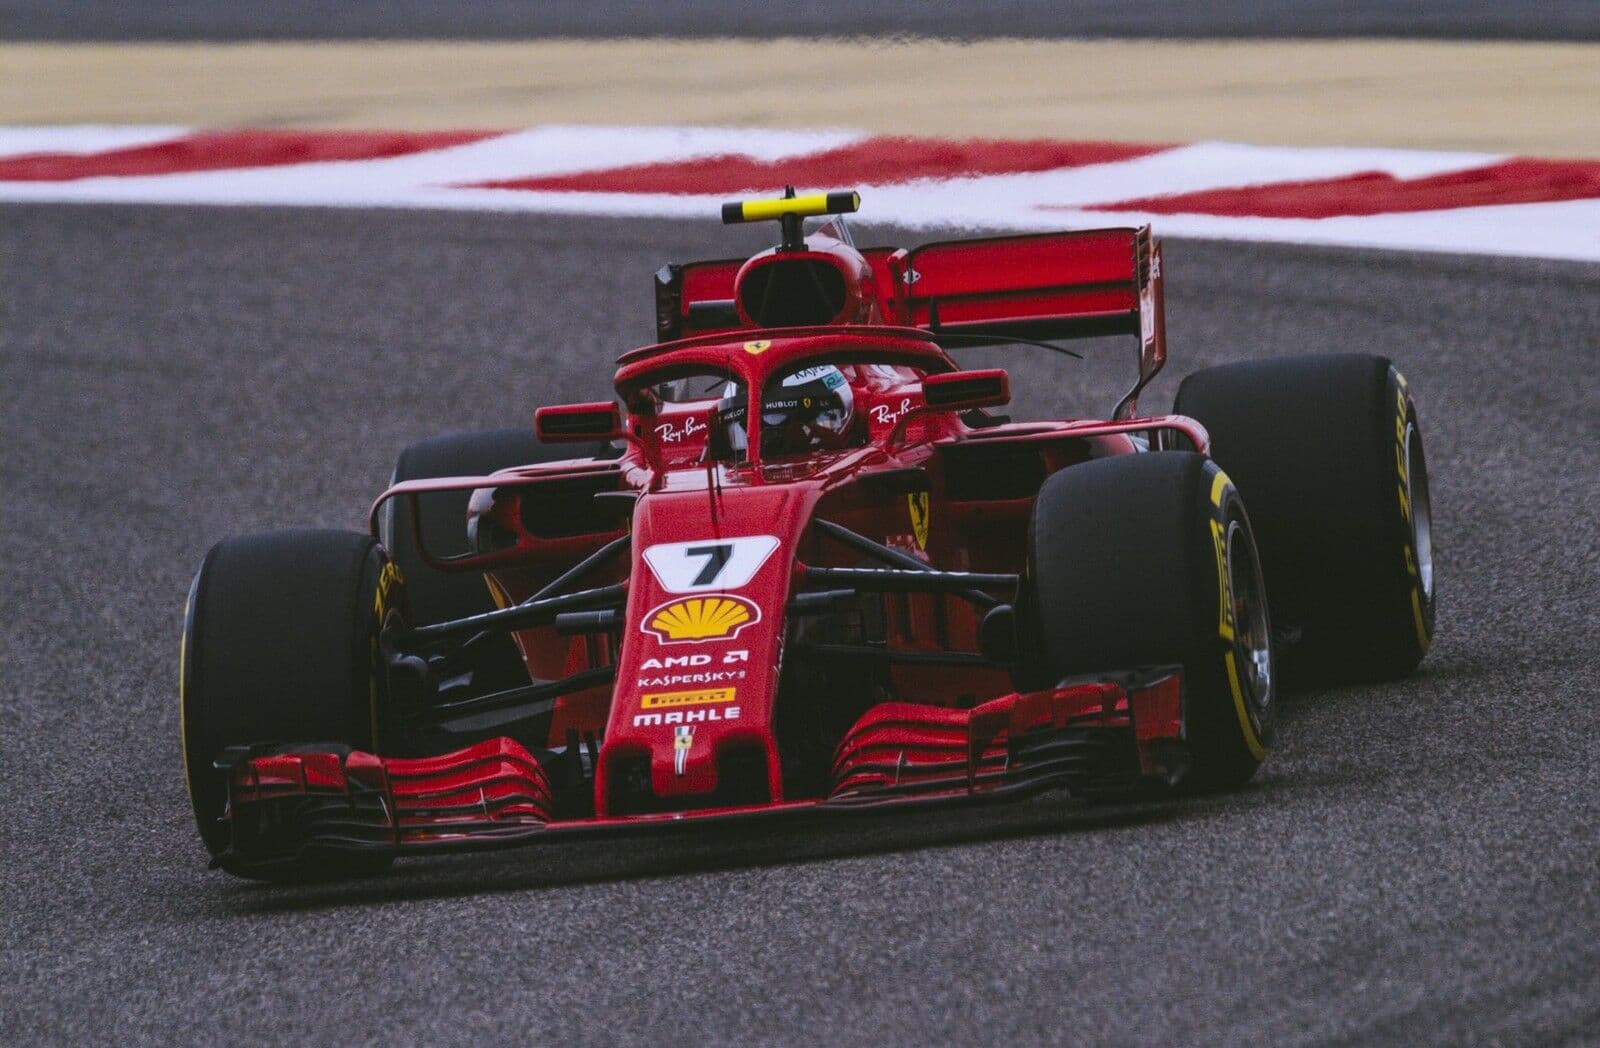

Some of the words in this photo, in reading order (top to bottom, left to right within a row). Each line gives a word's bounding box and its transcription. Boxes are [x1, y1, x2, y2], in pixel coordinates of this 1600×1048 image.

[766, 400, 798, 409] HUBLOT
[870, 398, 921, 424] Ray-B
[654, 416, 707, 442] Ray-Ban
[685, 544, 735, 587] 7
[640, 655, 712, 670] AMD
[637, 671, 736, 687] KASPERSKY
[633, 707, 741, 727] MAHLE
